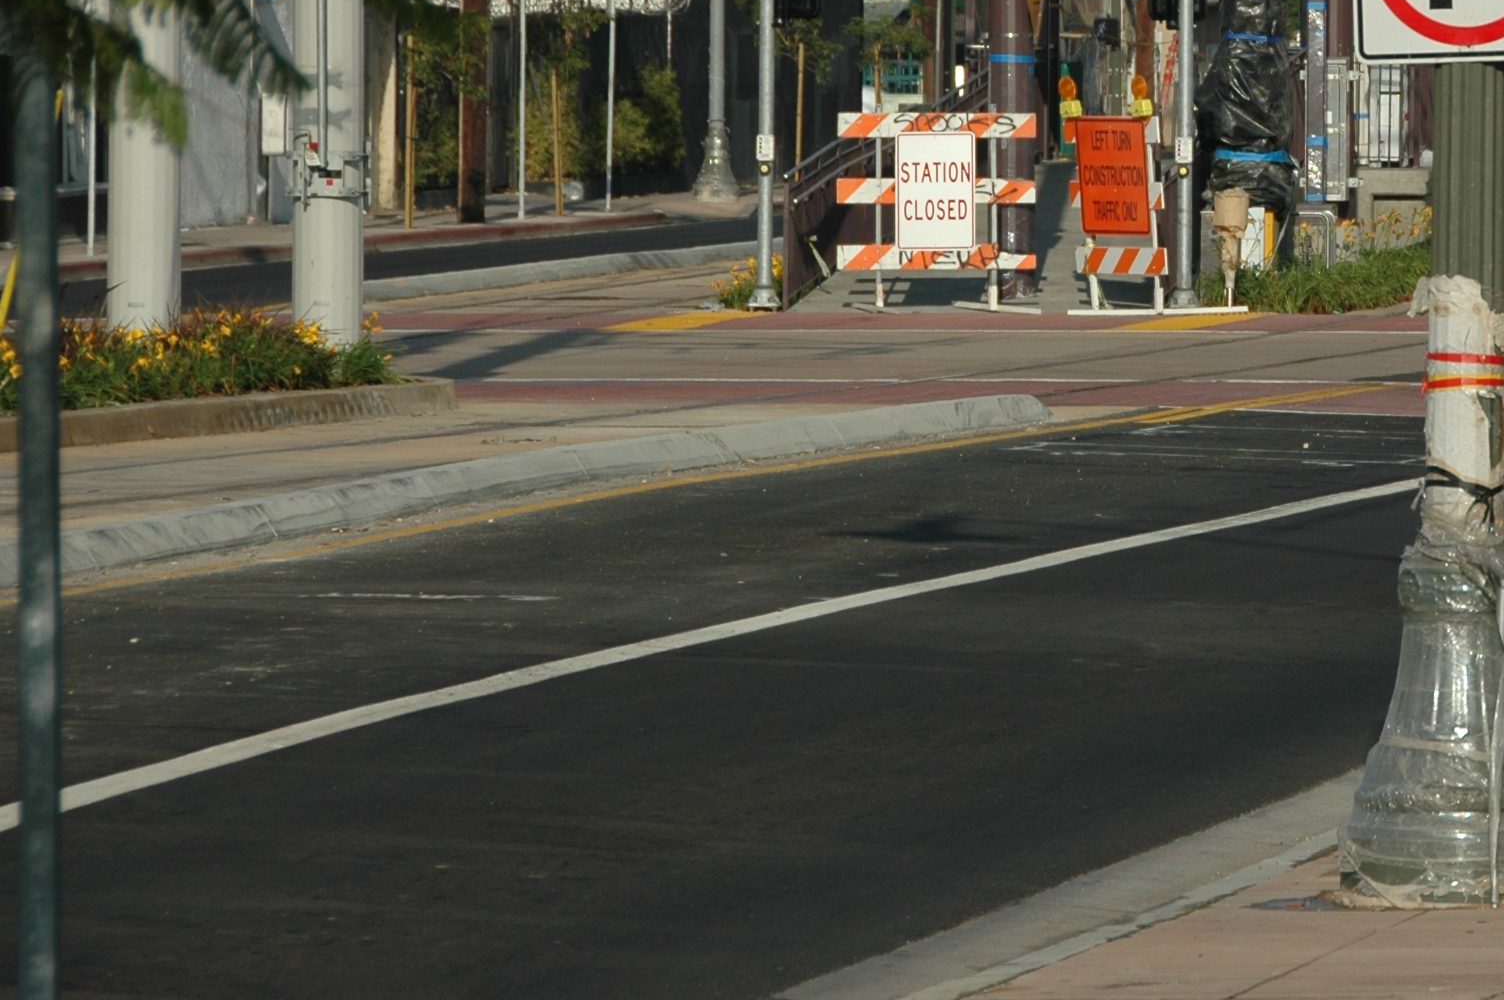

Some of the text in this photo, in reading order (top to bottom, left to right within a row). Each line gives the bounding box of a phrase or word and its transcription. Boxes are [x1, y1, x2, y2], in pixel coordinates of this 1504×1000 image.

[1091, 129, 1132, 151] LEFT TURN
[900, 162, 971, 184] STATION
[1083, 164, 1144, 187] CONSTRUCTION
[903, 199, 969, 221] CLOSED
[1093, 200, 1138, 223] TRAFFIC ONLY
